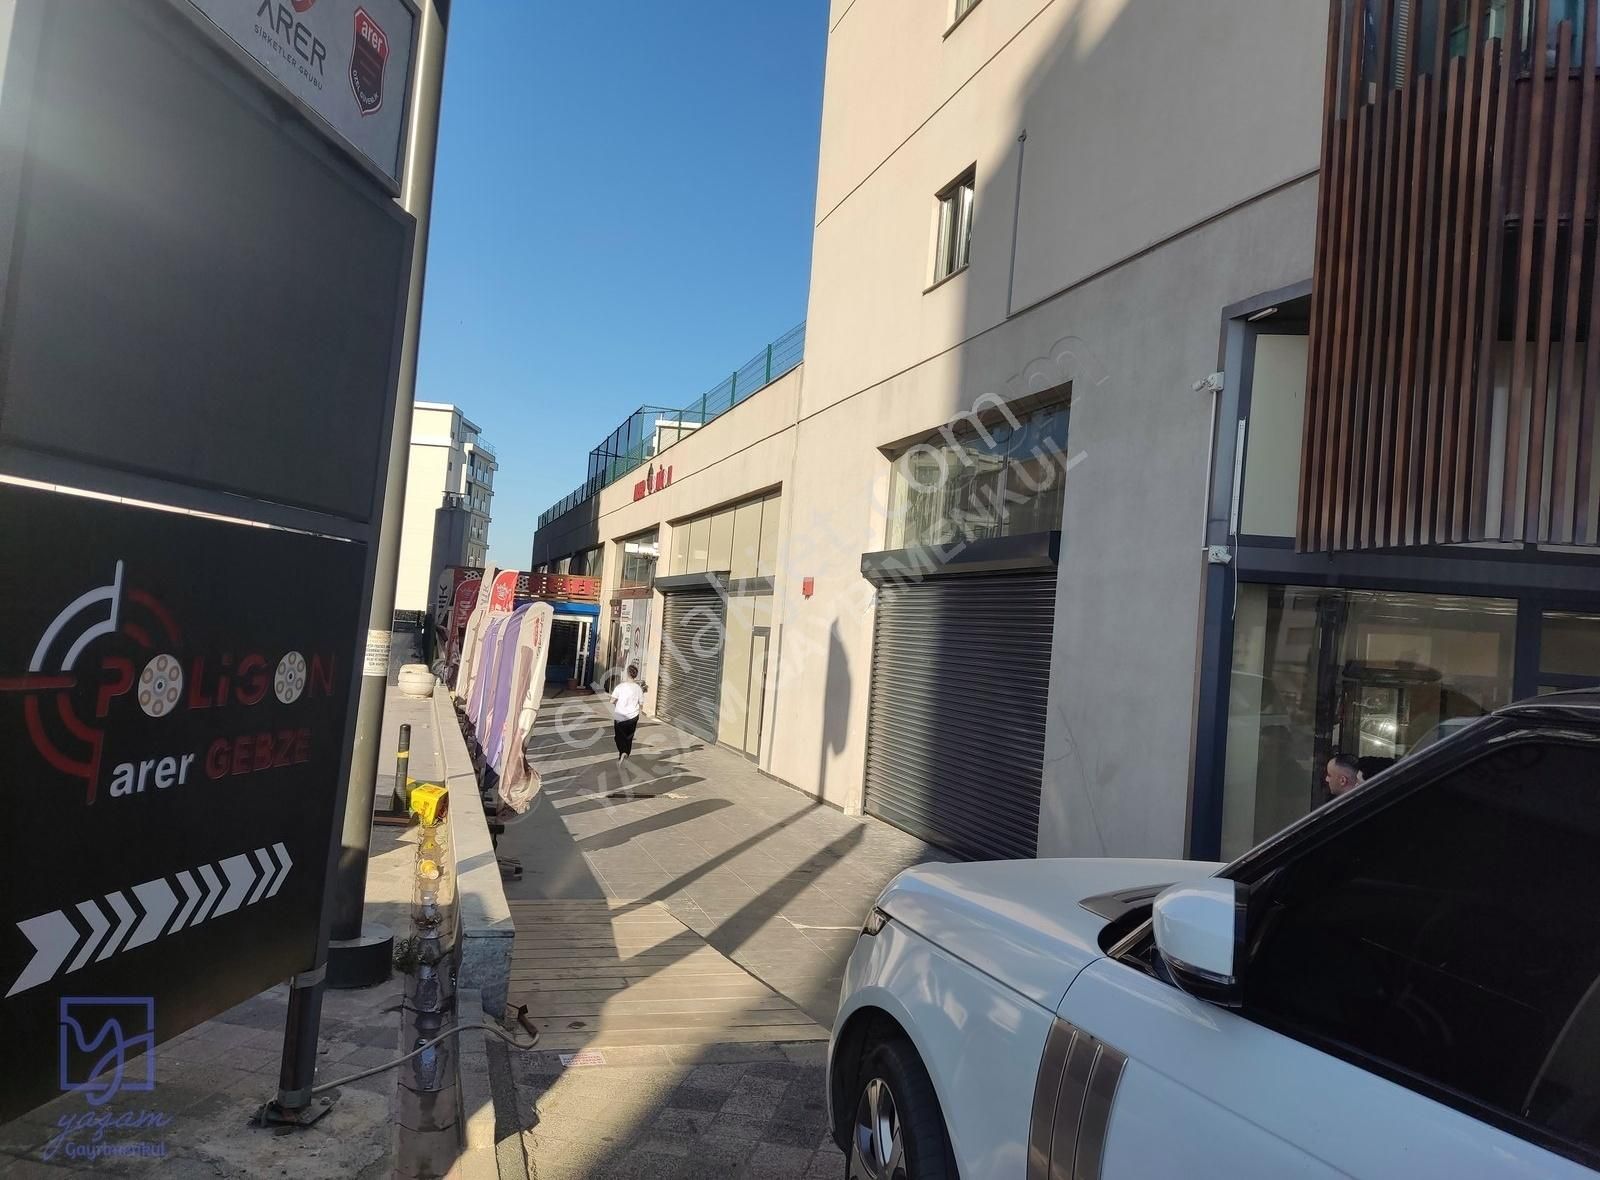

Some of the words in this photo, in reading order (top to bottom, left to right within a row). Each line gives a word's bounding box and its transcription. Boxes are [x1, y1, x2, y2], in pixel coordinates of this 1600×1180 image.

[256, 0, 327, 76] ARER
[361, 19, 384, 54] arer
[109, 752, 195, 798] arer
[204, 729, 312, 780] GEBZE
